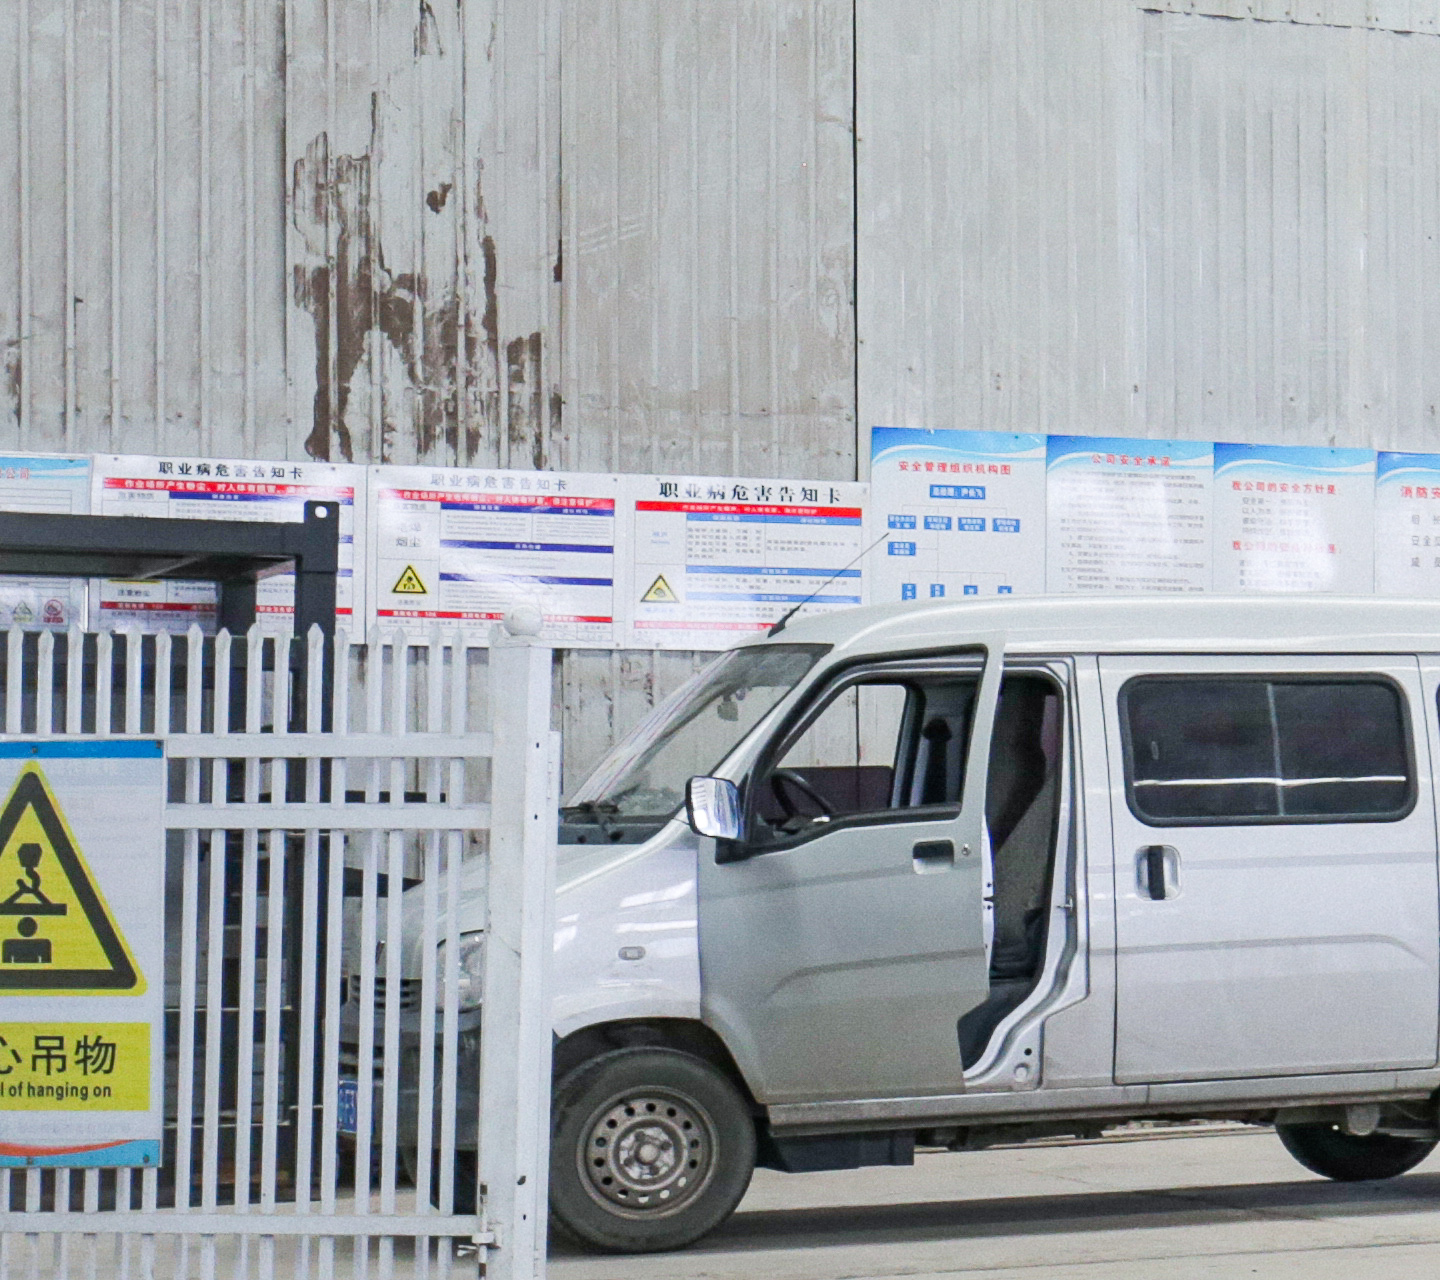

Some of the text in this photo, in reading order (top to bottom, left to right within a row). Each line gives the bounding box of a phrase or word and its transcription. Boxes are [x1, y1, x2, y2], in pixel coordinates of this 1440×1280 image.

[158, 461, 304, 480] 职业病危害告知卡
[431, 473, 567, 492] 职业病危害告知卡
[659, 481, 841, 504] 职业病危害告知卡
[9, 1081, 22, 1097] of
[27, 1081, 89, 1101] hanging
[93, 1085, 111, 1098] on
